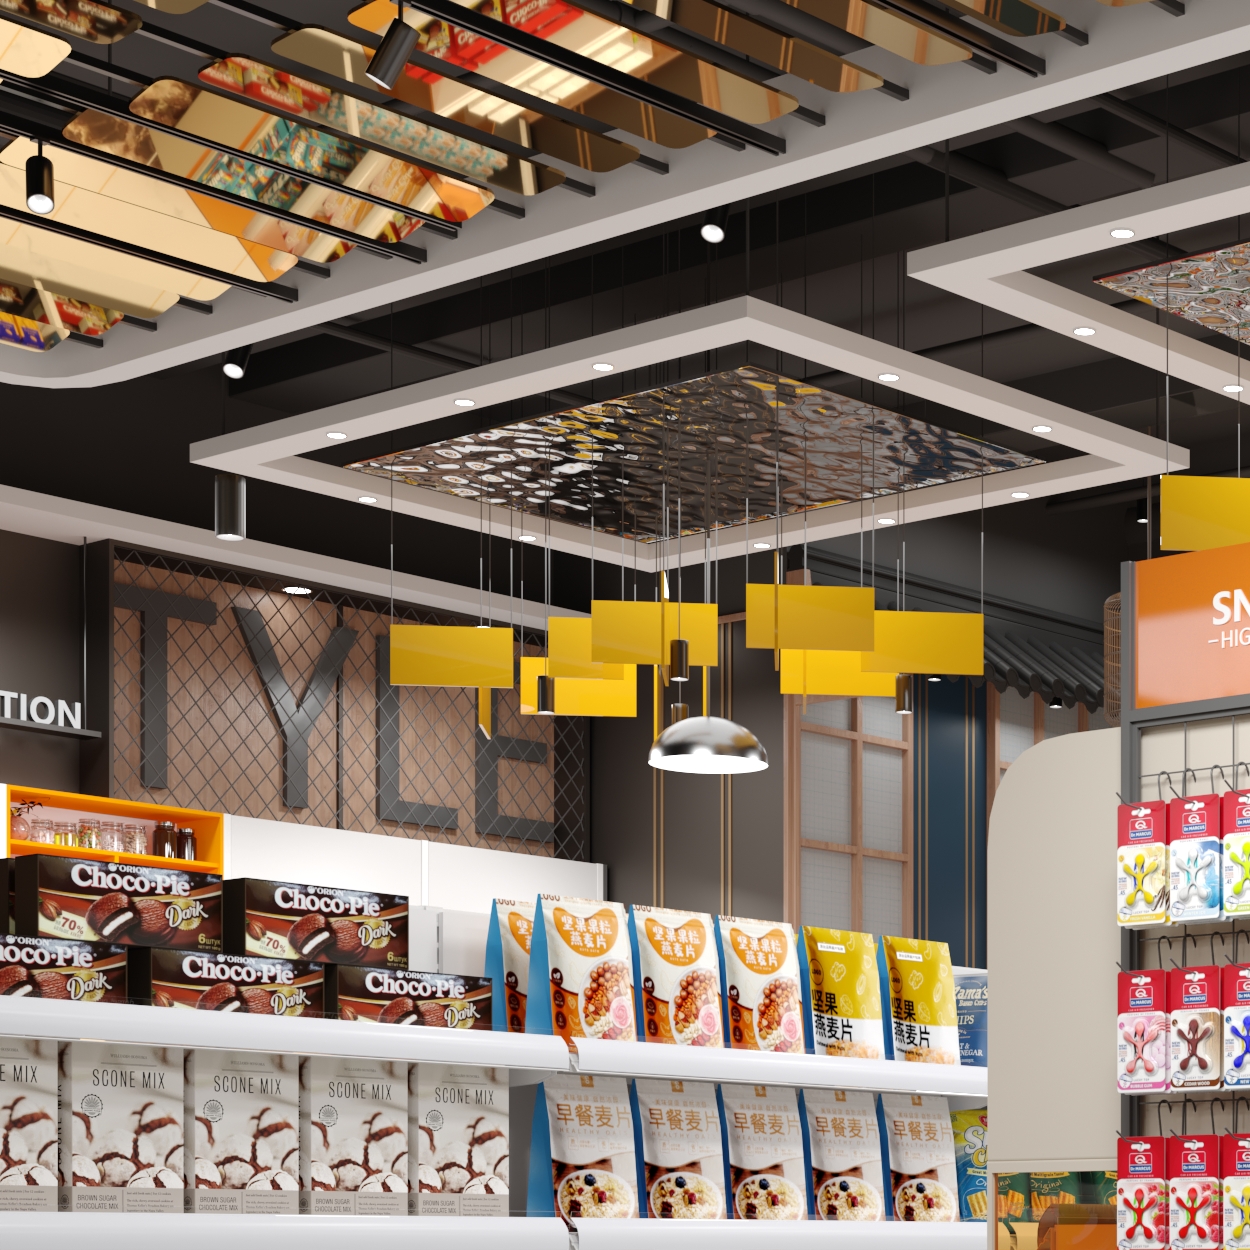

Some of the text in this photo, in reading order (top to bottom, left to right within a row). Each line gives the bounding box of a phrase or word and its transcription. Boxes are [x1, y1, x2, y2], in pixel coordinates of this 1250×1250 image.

[165, 902, 209, 928] Dark
[561, 914, 612, 935] 坚果果粒
[358, 921, 396, 947] Dark
[570, 931, 607, 948] 燕麦片
[652, 926, 701, 944] 坚果果粒
[737, 933, 782, 954] 坚果果粒
[660, 942, 695, 958] 燕麦片
[745, 950, 778, 967] 燕麦片
[811, 989, 838, 1015] 坚果
[891, 997, 915, 1022] 坚果
[444, 1003, 481, 1028] Dark
[814, 1014, 853, 1042] 燕麦片
[894, 1021, 930, 1048] 燕麦片
[142, 1072, 165, 1090] MIX
[213, 1075, 254, 1094] SCONE
[328, 1082, 392, 1100] SCONE MIX
[435, 1087, 494, 1105] SCONE MIX
[556, 1103, 632, 1129] 早餐麦片
[649, 1107, 719, 1132] 早餐麦片
[815, 1116, 878, 1139] 早餐麦片
[76, 1202, 106, 1210] CHOCOLATE
[77, 1194, 117, 1202] BROWN SUGAR
